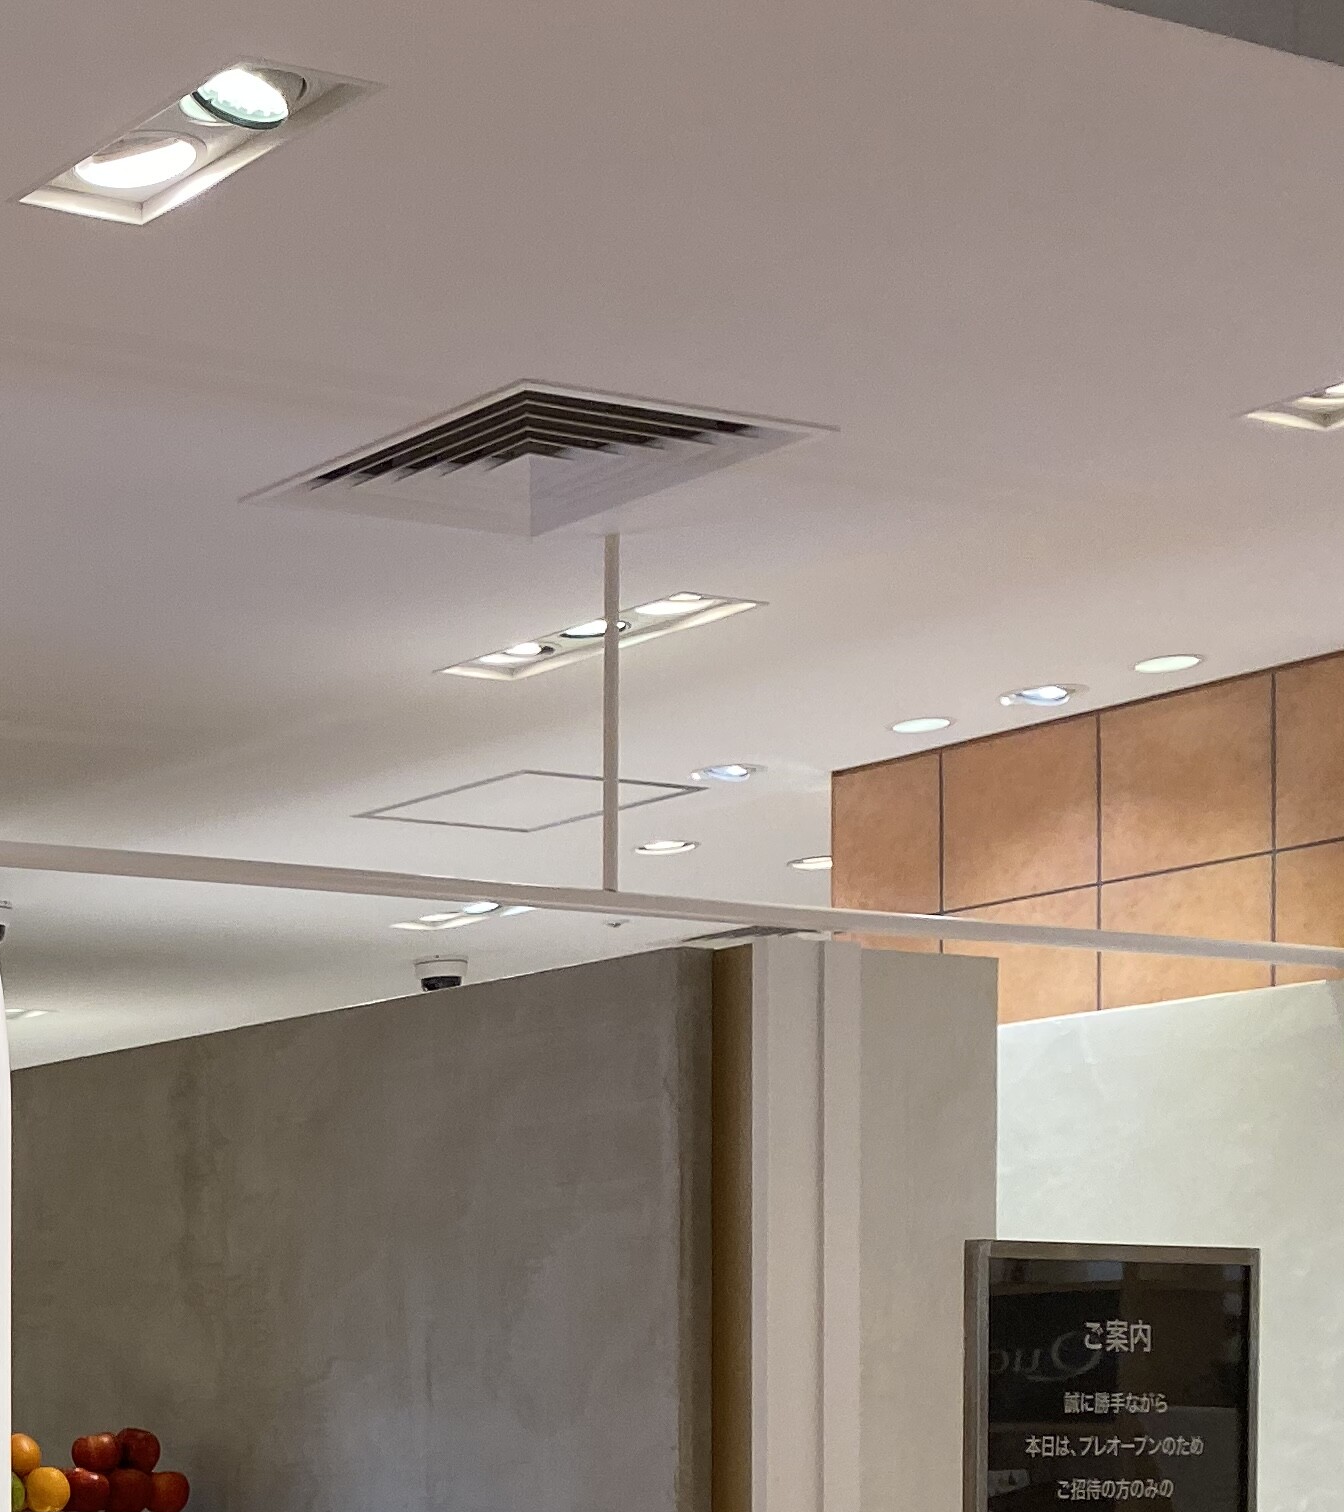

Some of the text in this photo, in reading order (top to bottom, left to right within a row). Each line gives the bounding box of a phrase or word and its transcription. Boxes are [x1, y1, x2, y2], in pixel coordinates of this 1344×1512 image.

[1084, 1318, 1153, 1353] ご案内
[1063, 1392, 1169, 1415] 誠に勝手ながら
[1024, 1435, 1205, 1459] 本日は、プレオープンのため
[1056, 1478, 1175, 1502] ご招待の方のみの
